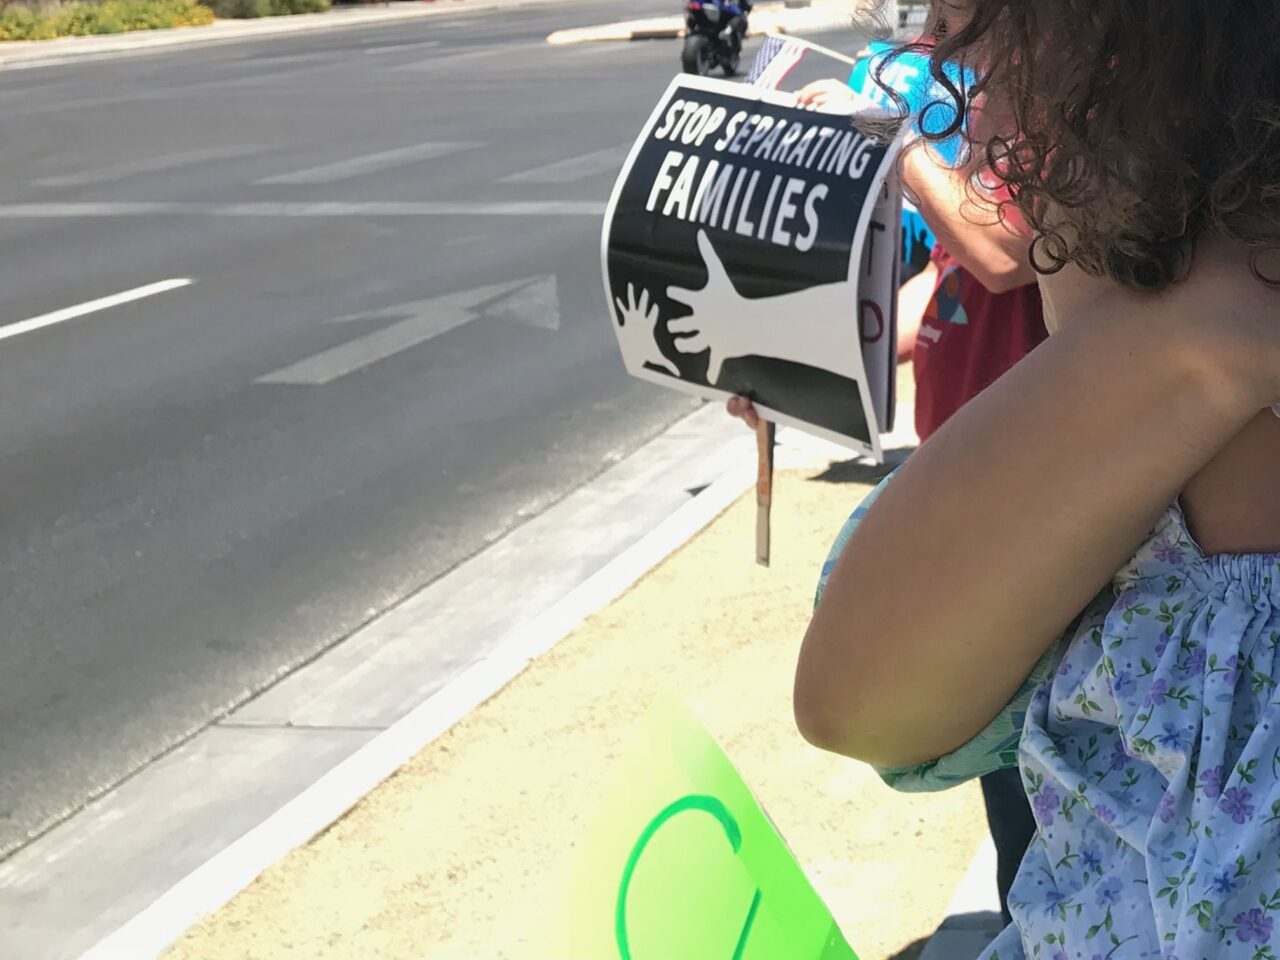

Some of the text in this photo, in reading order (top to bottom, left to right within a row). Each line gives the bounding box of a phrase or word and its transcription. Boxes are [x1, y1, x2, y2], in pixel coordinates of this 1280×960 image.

[654, 99, 877, 180] STOP SEPARATING
[645, 150, 829, 252] FAMILIES
